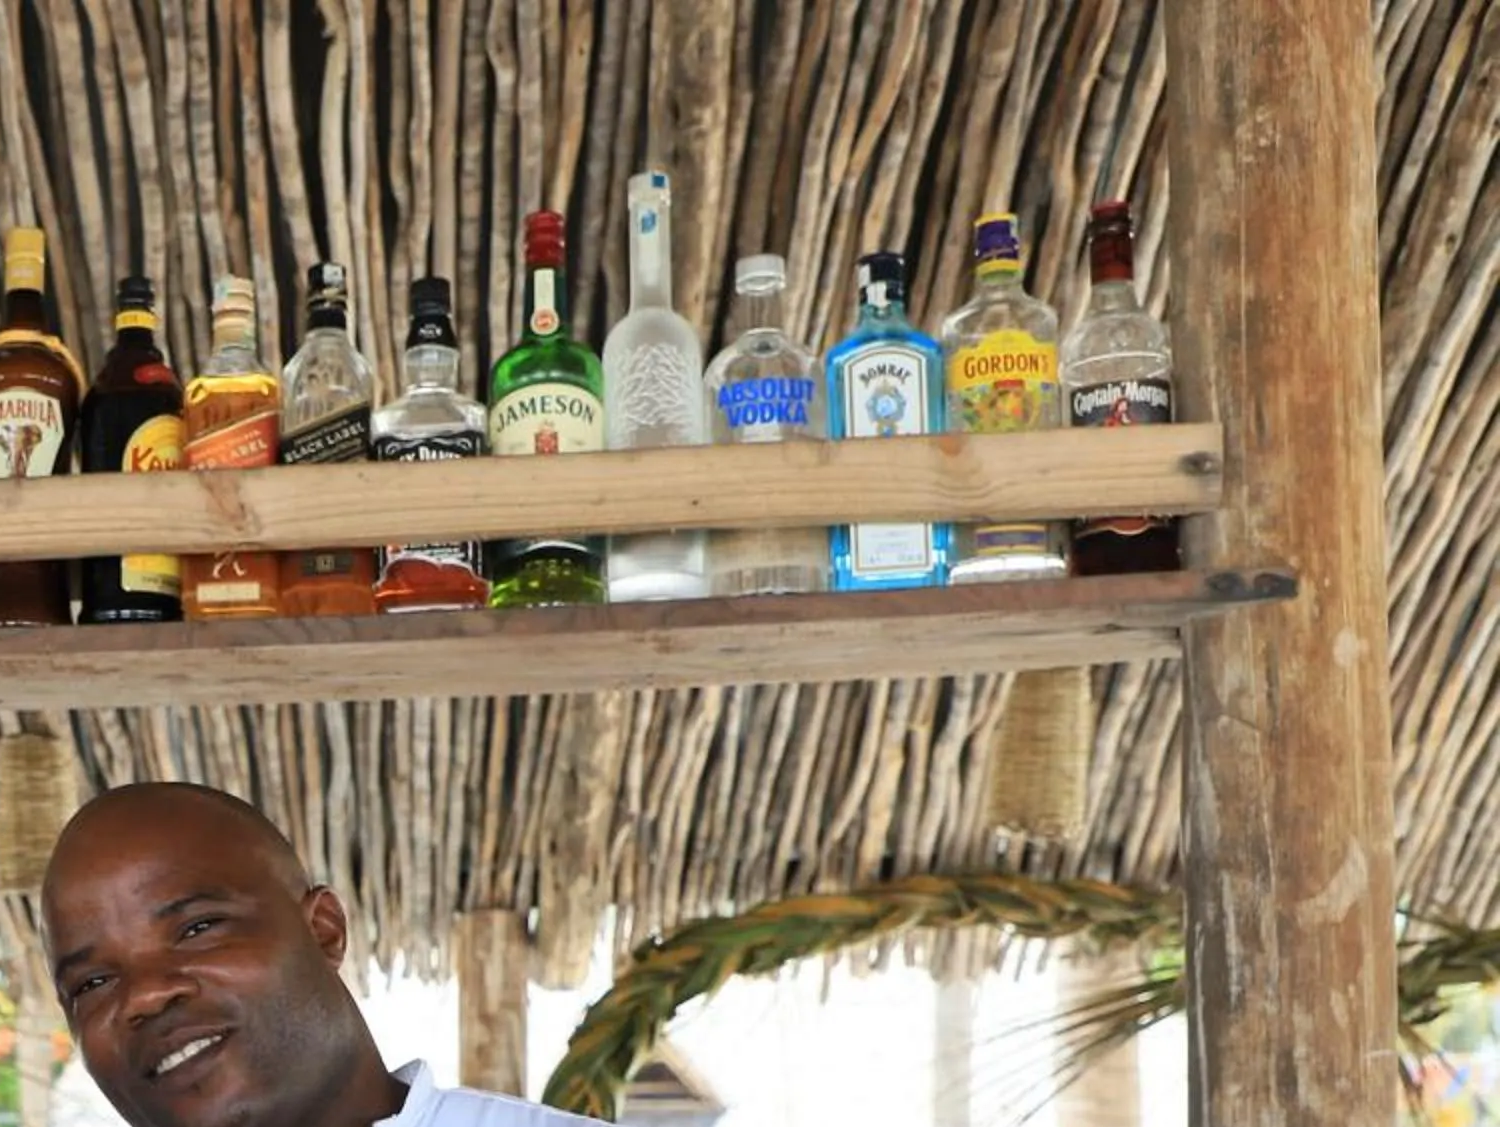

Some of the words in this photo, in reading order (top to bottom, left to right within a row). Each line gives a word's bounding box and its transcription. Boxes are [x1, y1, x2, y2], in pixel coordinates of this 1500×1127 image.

[859, 364, 911, 388] BOMBAY
[718, 378, 815, 408] ABSOLUT
[1073, 383, 1120, 417] Captain
[496, 395, 594, 433] JAMESON
[727, 401, 808, 428] VODKA
[284, 439, 325, 463] BLACK
[325, 421, 365, 446] LABEL
